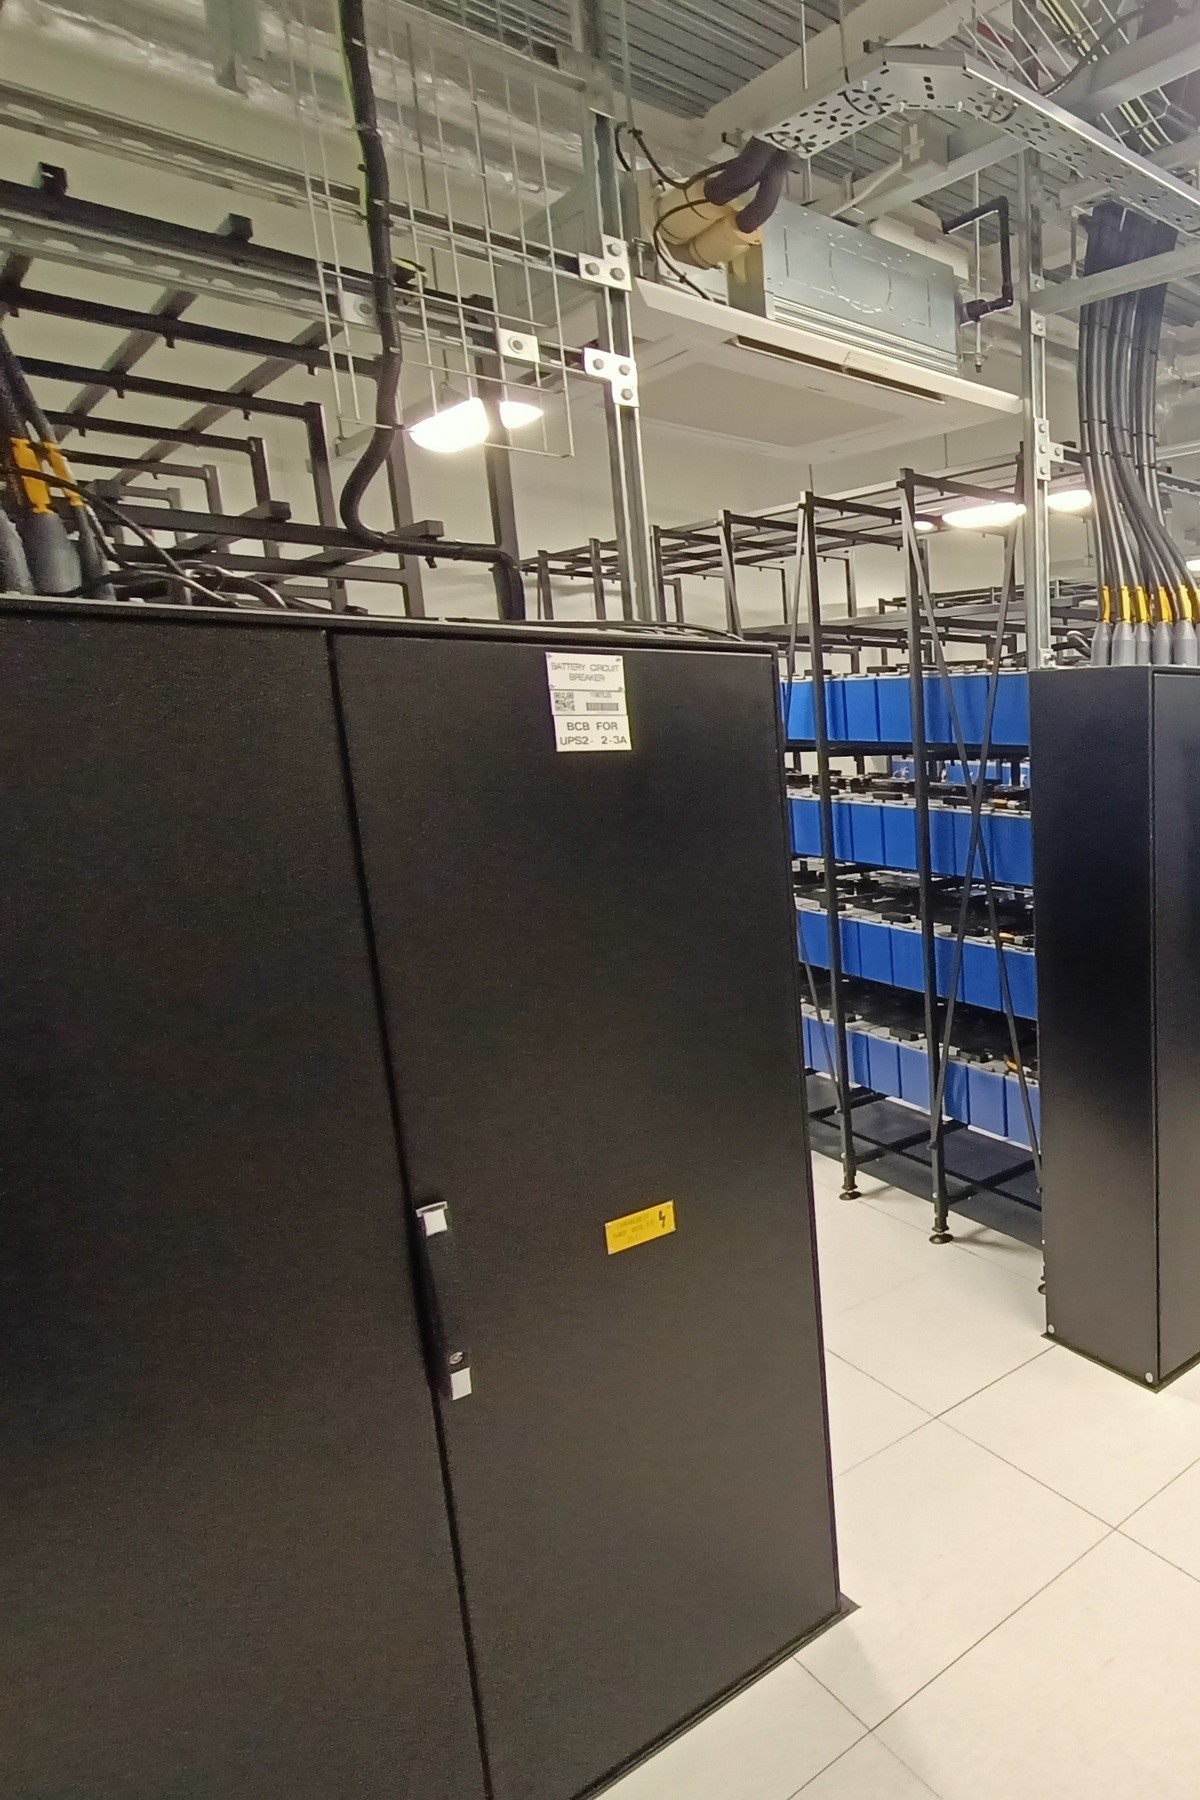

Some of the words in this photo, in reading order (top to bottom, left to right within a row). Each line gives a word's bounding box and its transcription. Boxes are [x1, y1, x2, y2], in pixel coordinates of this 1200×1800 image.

[551, 662, 585, 671] BATTERY
[589, 664, 620, 672] CIRCUIT
[569, 673, 605, 682] BREAKER
[566, 722, 590, 731] BCB
[596, 722, 618, 731] FOR
